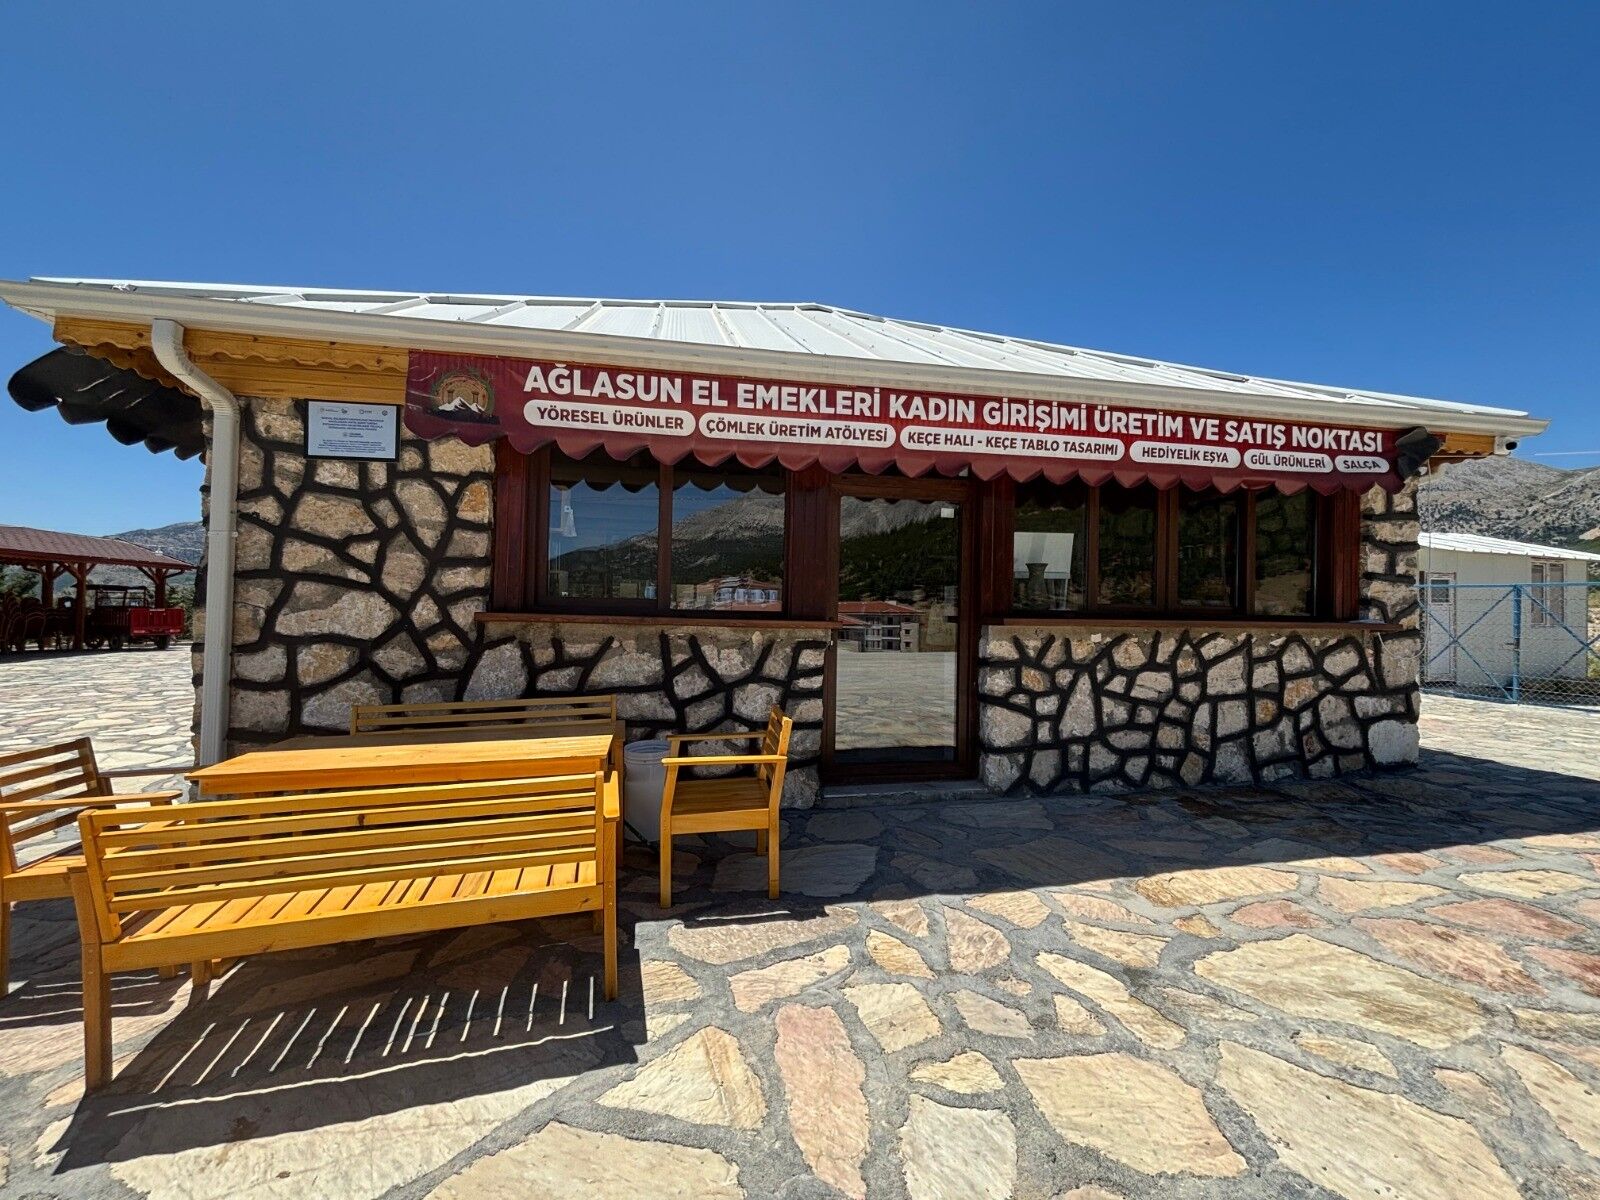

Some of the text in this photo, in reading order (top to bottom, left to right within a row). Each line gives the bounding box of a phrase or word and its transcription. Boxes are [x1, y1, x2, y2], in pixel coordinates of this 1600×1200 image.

[523, 363, 1383, 452] AĞLASUN EL EMEKLERİ KADIN GİRİŞİMİ ÜRETİM VE SATIŞ NOKTASI
[537, 405, 684, 430] YÖRESEL ÜRÜNLER
[706, 416, 888, 442] ÇÖMLEK ÜRETİM ATÖLYESİ
[908, 432, 941, 447] KEÇE
[944, 434, 974, 447] HALI
[985, 436, 1017, 451] KEÇE
[1020, 438, 1060, 451] TABLO
[1063, 441, 1118, 456] TASARIMI
[1142, 446, 1229, 464] HEDİYELİK EŞYA
[1250, 451, 1326, 469] GÜL ÜRÜNLERİ
[1343, 459, 1382, 471] SALÇA
